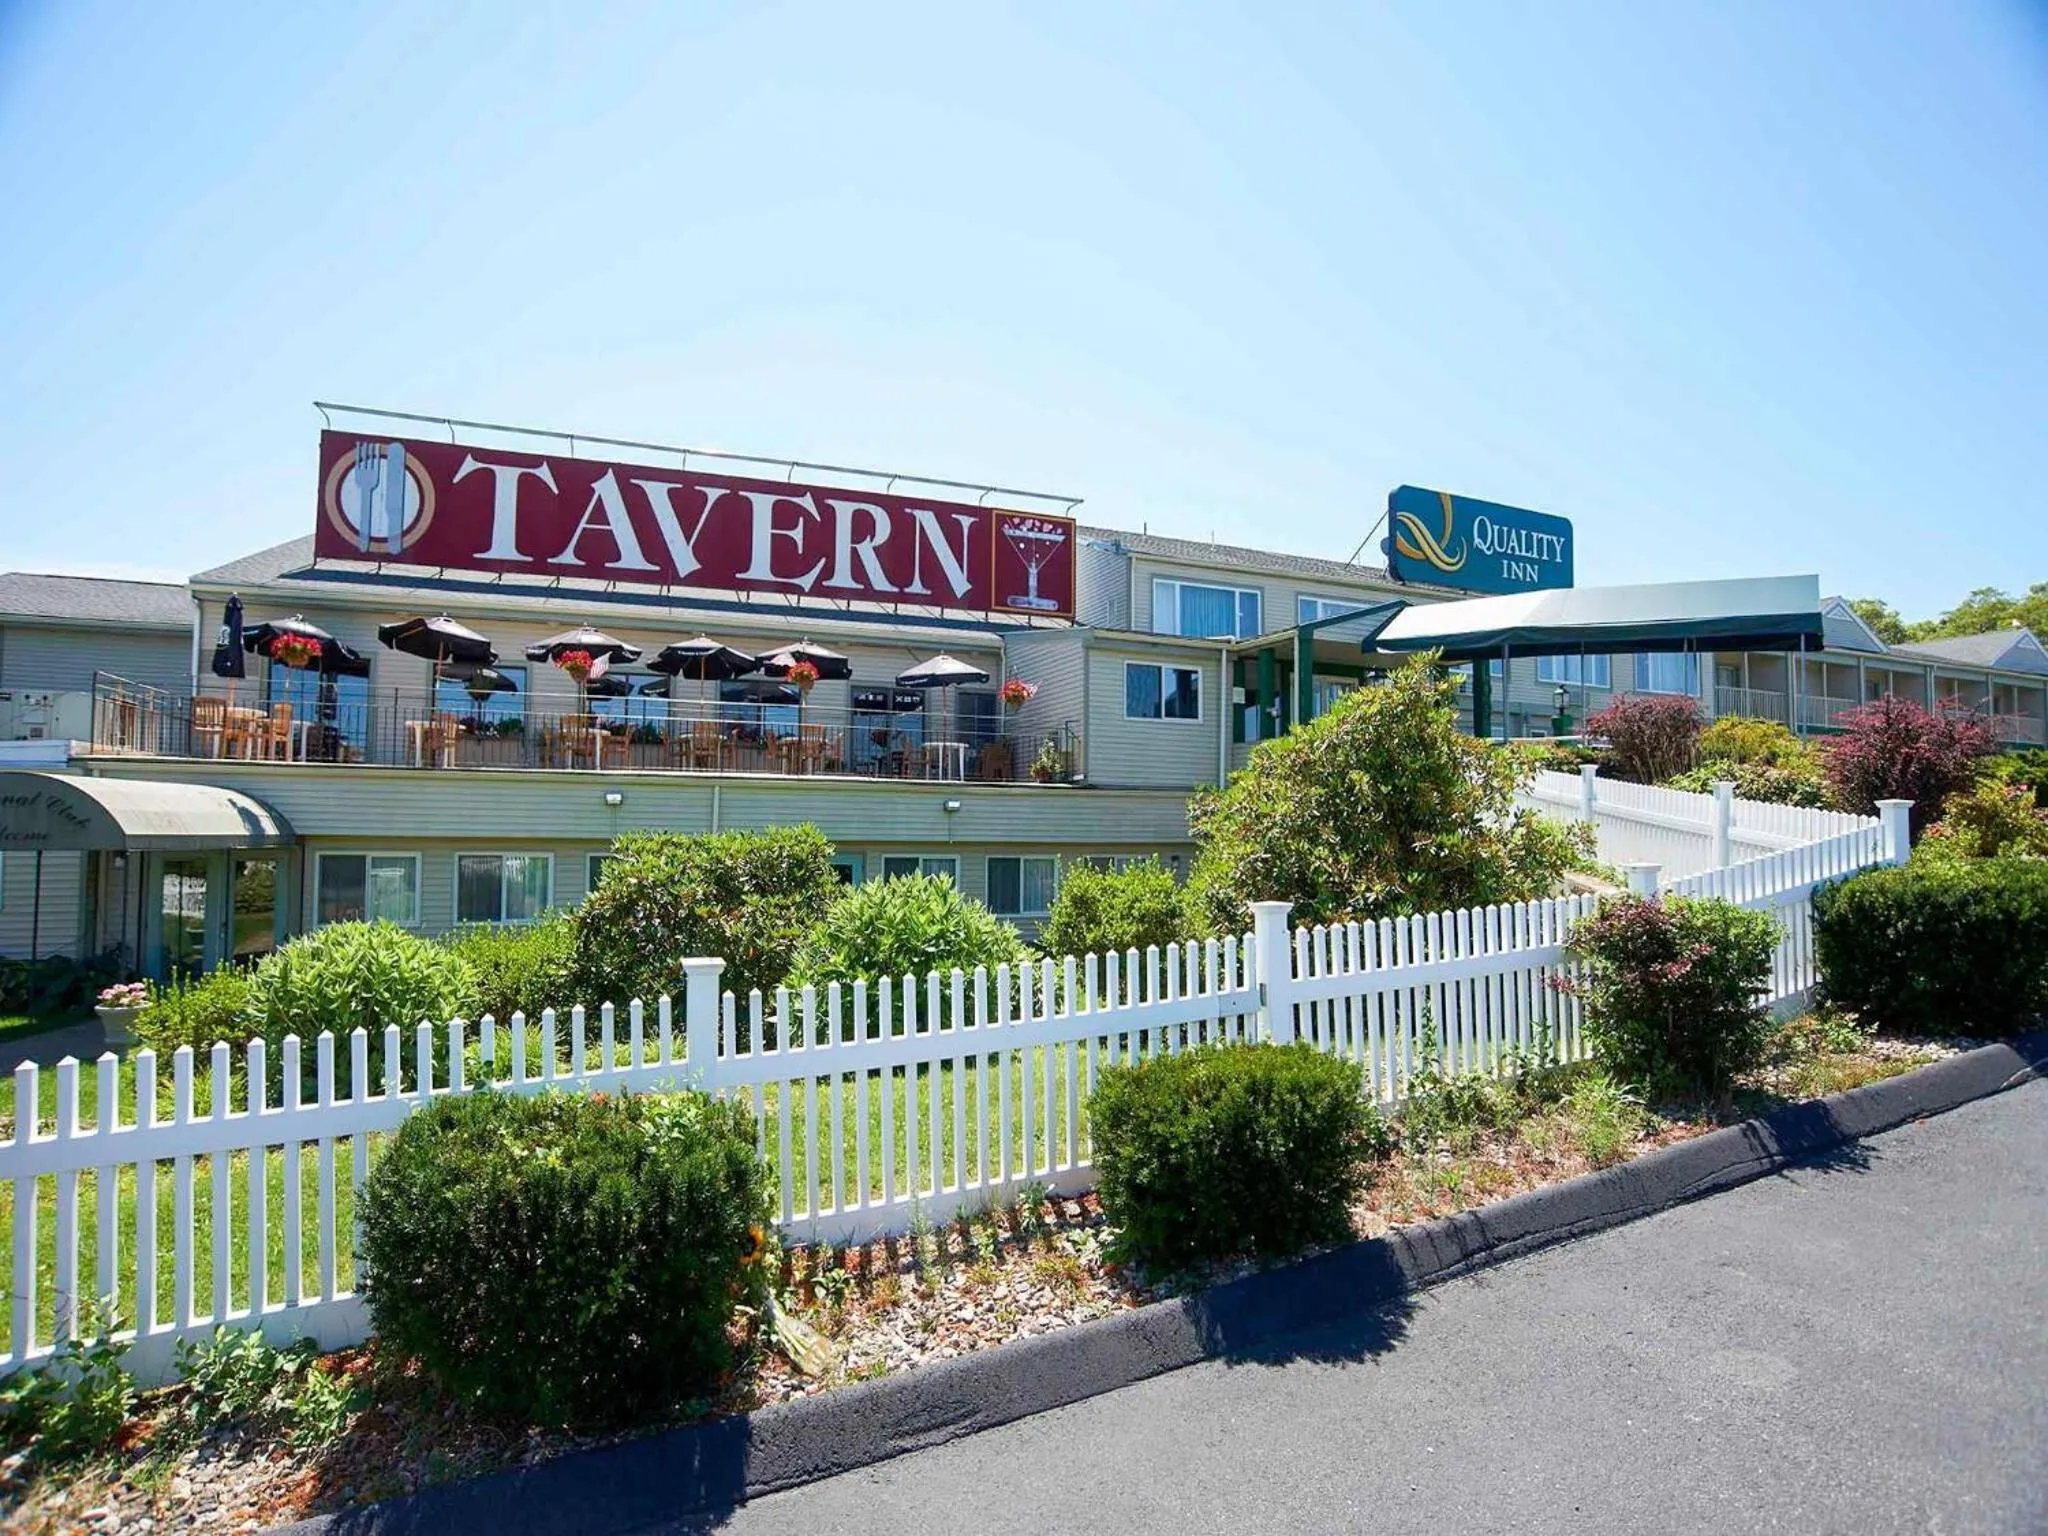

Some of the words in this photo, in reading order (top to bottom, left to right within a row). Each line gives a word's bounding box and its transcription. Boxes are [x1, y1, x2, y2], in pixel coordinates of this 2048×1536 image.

[451, 454, 979, 600] TAVERN
[1474, 515, 1565, 562] QUALITY
[1503, 560, 1538, 583] INN
